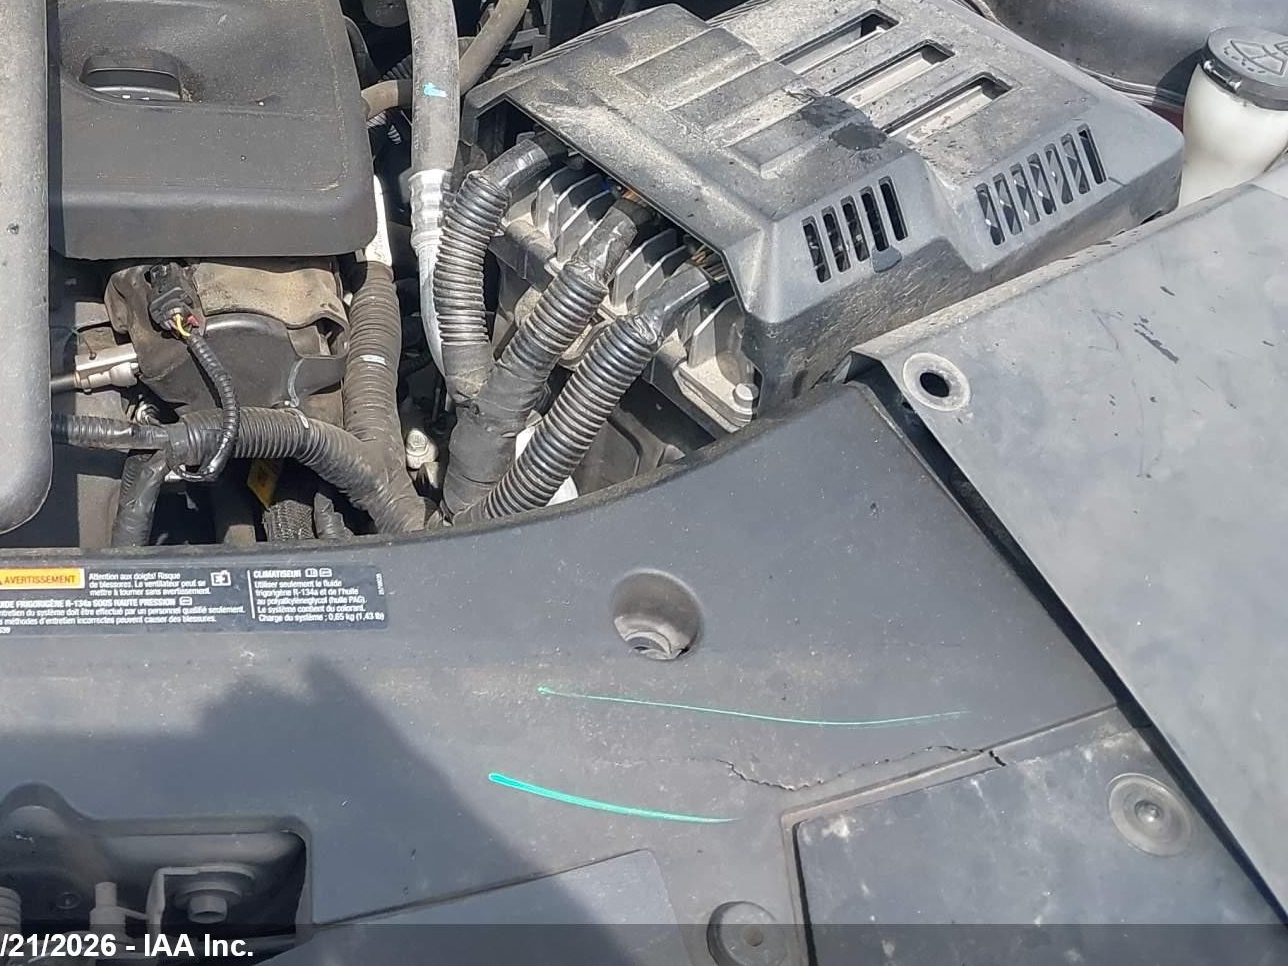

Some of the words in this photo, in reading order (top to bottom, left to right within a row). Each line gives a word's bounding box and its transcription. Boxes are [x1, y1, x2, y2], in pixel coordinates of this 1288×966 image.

[4, 575, 76, 584] AVERTISSEMENT
[89, 573, 119, 581] Attention
[133, 573, 156, 582] doigts!
[157, 572, 181, 581] Risque
[253, 570, 302, 579] CLIMATISEUR
[99, 581, 133, 589] blessures.
[144, 580, 180, 588] ventilateur
[181, 580, 197, 588] peut
[254, 581, 278, 589] Utiliser
[279, 580, 314, 589] seulement
[315, 580, 322, 588] le
[323, 579, 342, 588] fluide
[89, 589, 112, 597] mettre
[162, 587, 211, 595] avertissement.
[255, 589, 292, 598] frigorigène
[293, 588, 319, 597] R-134a
[319, 588, 327, 596] et
[328, 588, 337, 596] de
[338, 587, 359, 596] l'huile
[15, 598, 64, 608] FRIGORIGÈNE
[65, 599, 92, 607] R-134a
[92, 598, 113, 607] SOUS
[113, 598, 138, 607] HAUTE
[138, 597, 176, 607] PRESSION
[329, 595, 347, 605] (huile
[348, 594, 367, 604] PAG).
[25, 609, 35, 617] du
[36, 608, 65, 618] système
[66, 608, 79, 616] doit
[80, 607, 95, 616] être
[95, 607, 123, 616] effectué
[124, 607, 136, 616] par
[147, 607, 181, 616] personnel
[182, 606, 207, 615] qualifié
[208, 605, 246, 615] seulement.
[257, 605, 267, 614] Le
[268, 605, 296, 615] système
[297, 605, 325, 614] contient
[326, 605, 336, 613] du
[336, 604, 366, 613] colorant.
[4, 617, 38, 625] méthodes
[39, 617, 75, 626] d'entretien
[76, 616, 115, 625] incorrectes
[116, 616, 143, 625] peuvent
[144, 615, 167, 624] causer
[168, 615, 181, 623] des
[182, 615, 216, 624] blessures.
[258, 614, 283, 623] Charge
[283, 614, 294, 622] du
[294, 613, 324, 623] système
[328, 612, 344, 621] 0,65
[345, 613, 355, 622] kg
[356, 611, 374, 621] (1,43
[374, 612, 385, 621] lb)
